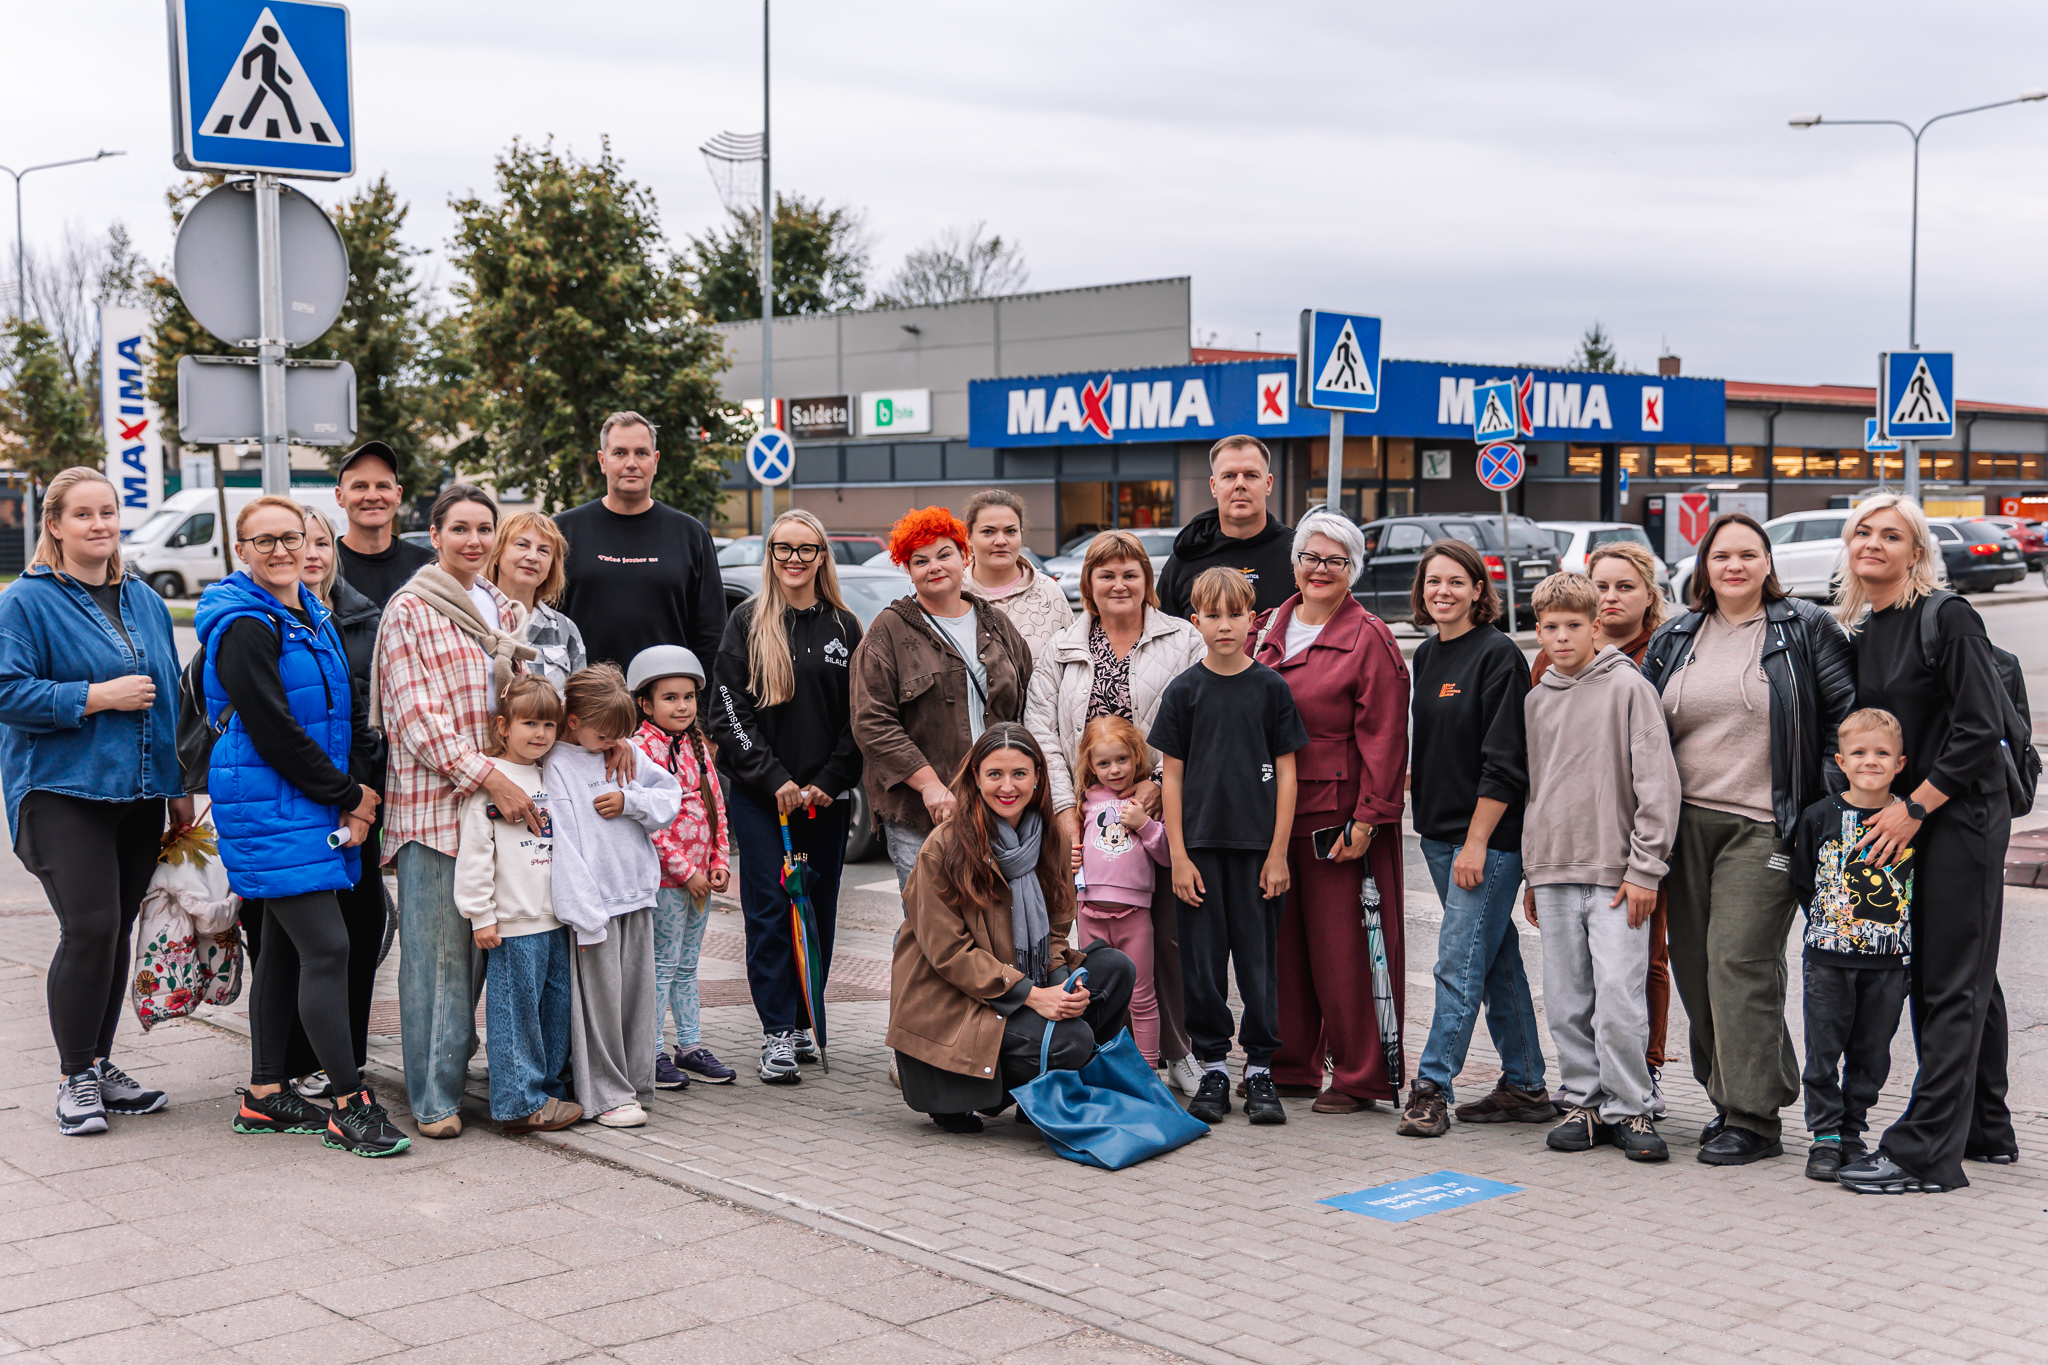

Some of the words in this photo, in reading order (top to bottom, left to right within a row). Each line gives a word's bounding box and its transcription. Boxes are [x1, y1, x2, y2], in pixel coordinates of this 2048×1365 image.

[117, 335, 149, 509] MAXIMA
[791, 403, 849, 426] Saldeta
[1007, 373, 1215, 439] MAXIMA
[1438, 371, 1613, 437] MXIMA
[824, 654, 848, 668] ŠILALĖ
[1092, 800, 1120, 812] MINNIE
